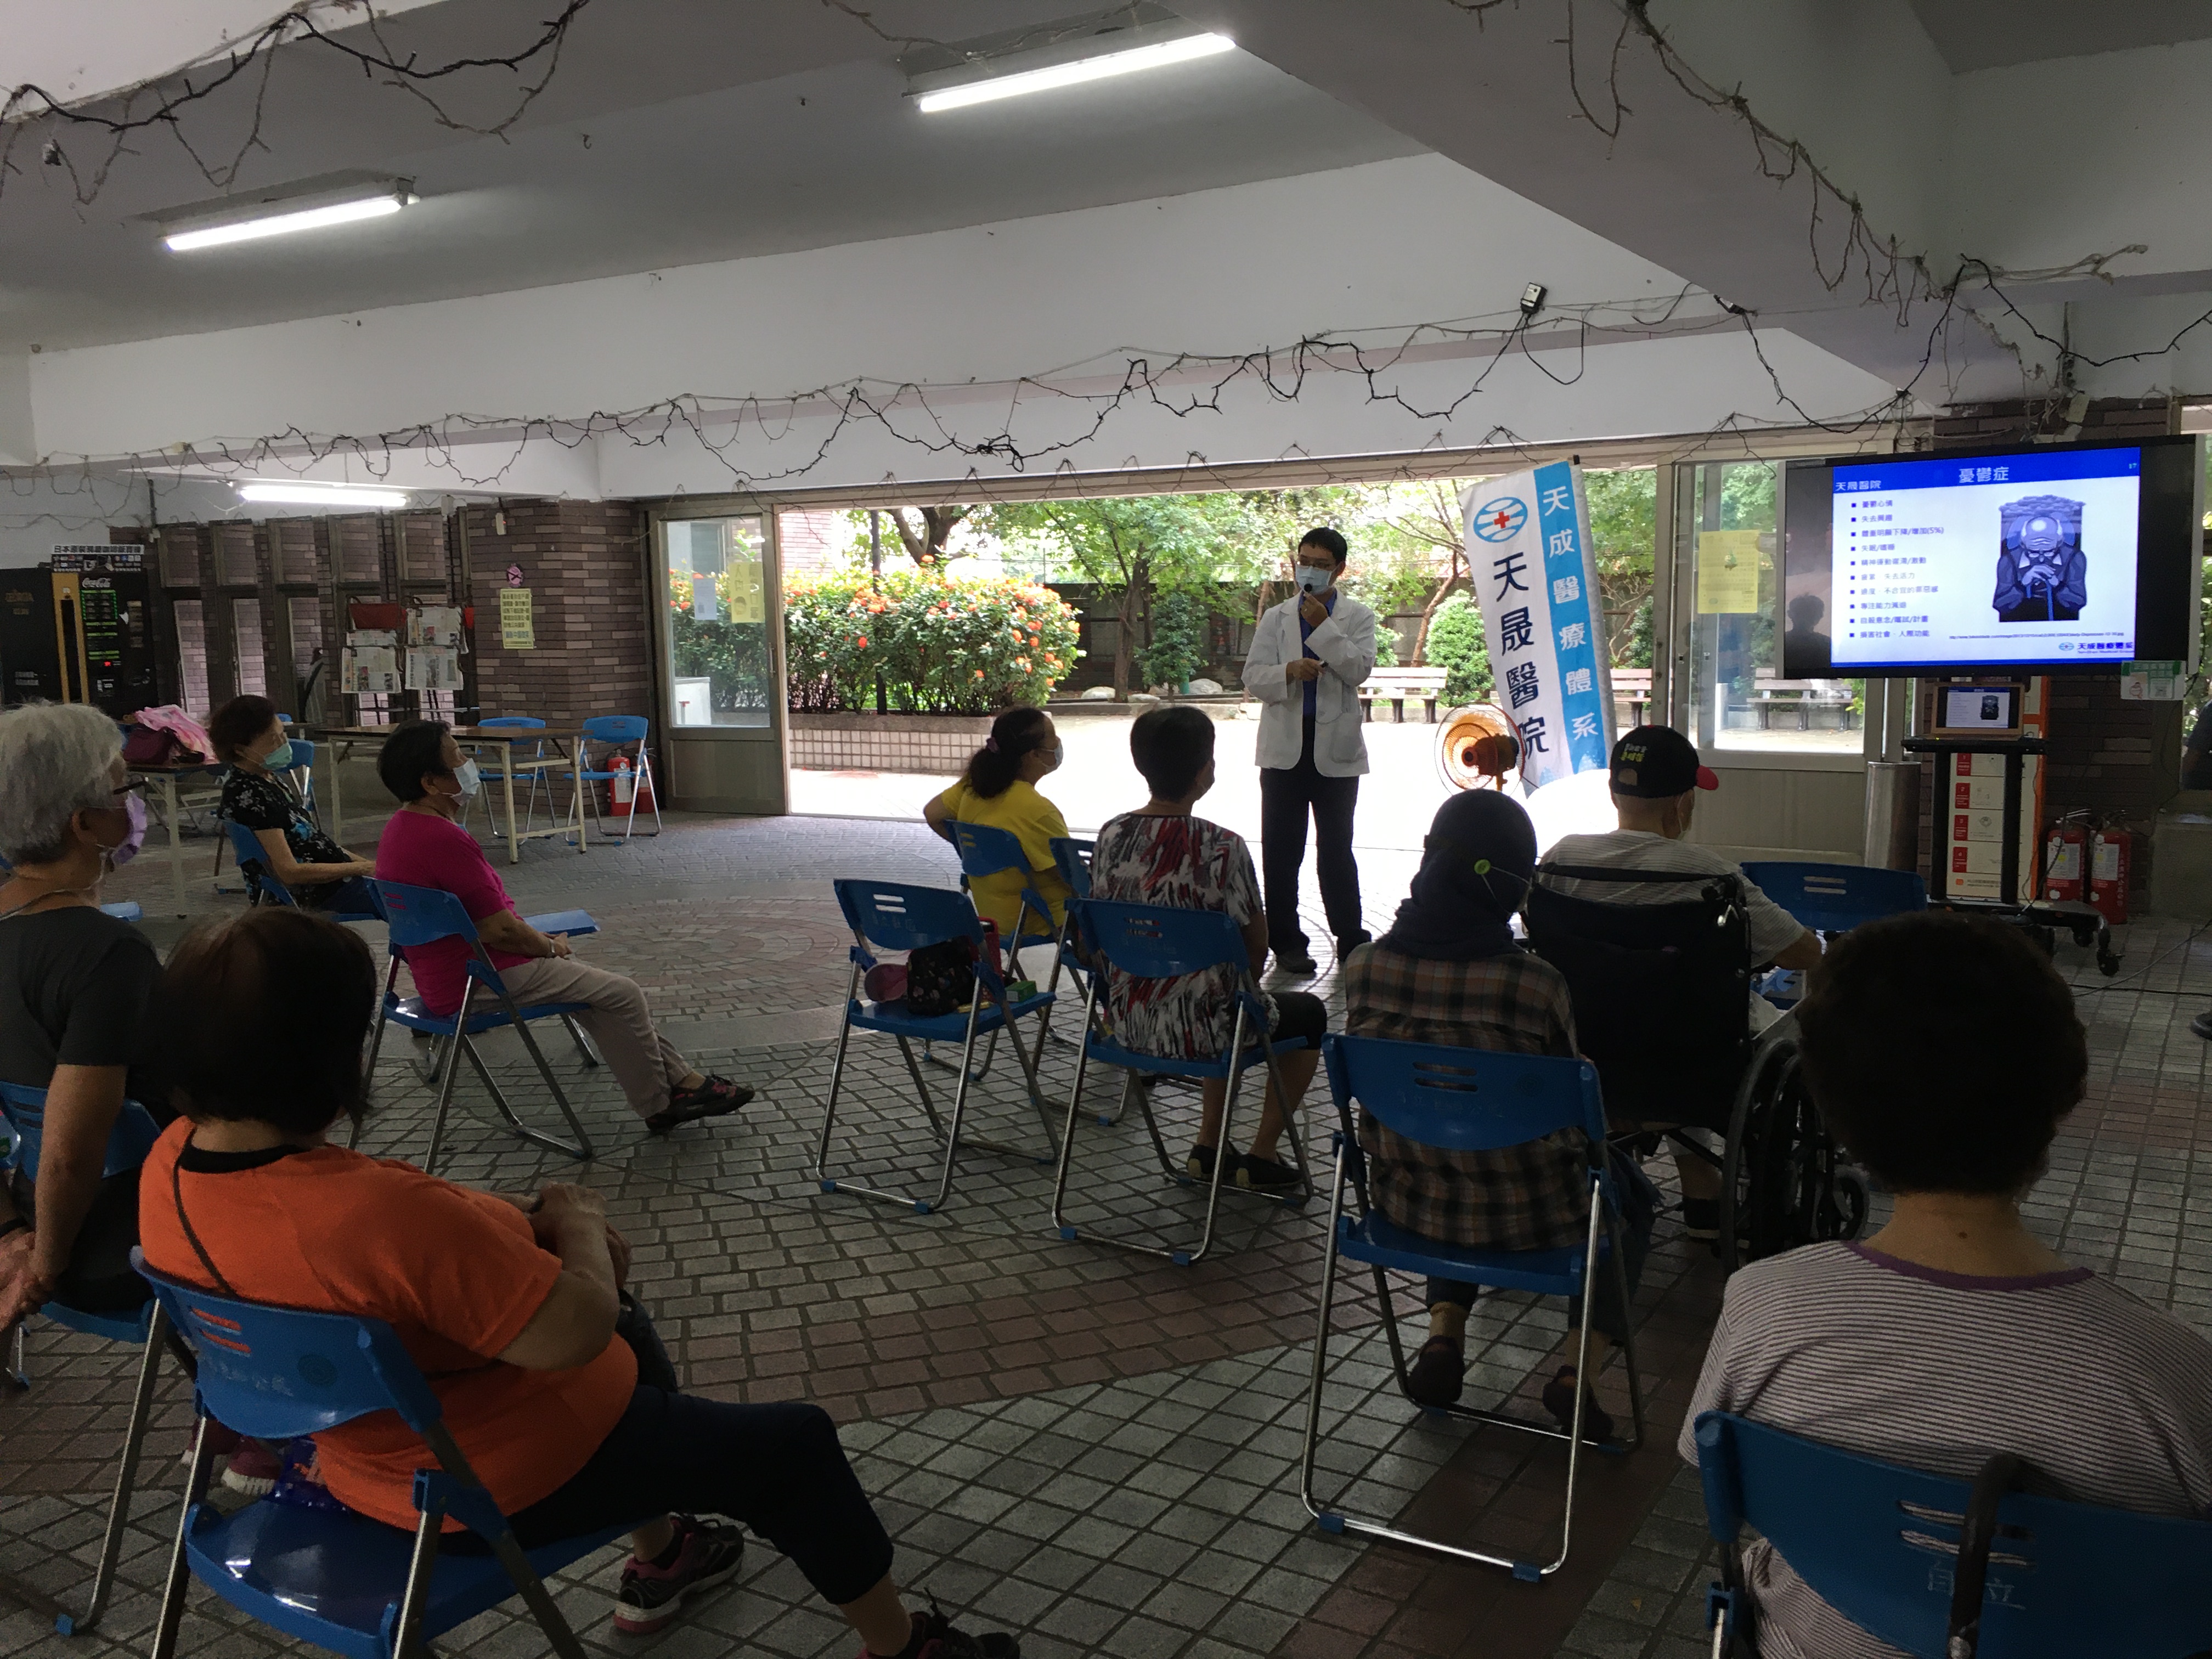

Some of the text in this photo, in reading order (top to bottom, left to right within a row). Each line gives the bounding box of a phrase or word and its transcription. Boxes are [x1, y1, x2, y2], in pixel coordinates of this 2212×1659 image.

[1959, 467, 2010, 483] 憂鬱症
[1493, 552, 1549, 760] 天晟醫院
[1543, 486, 1599, 741] 天成醫療體系
